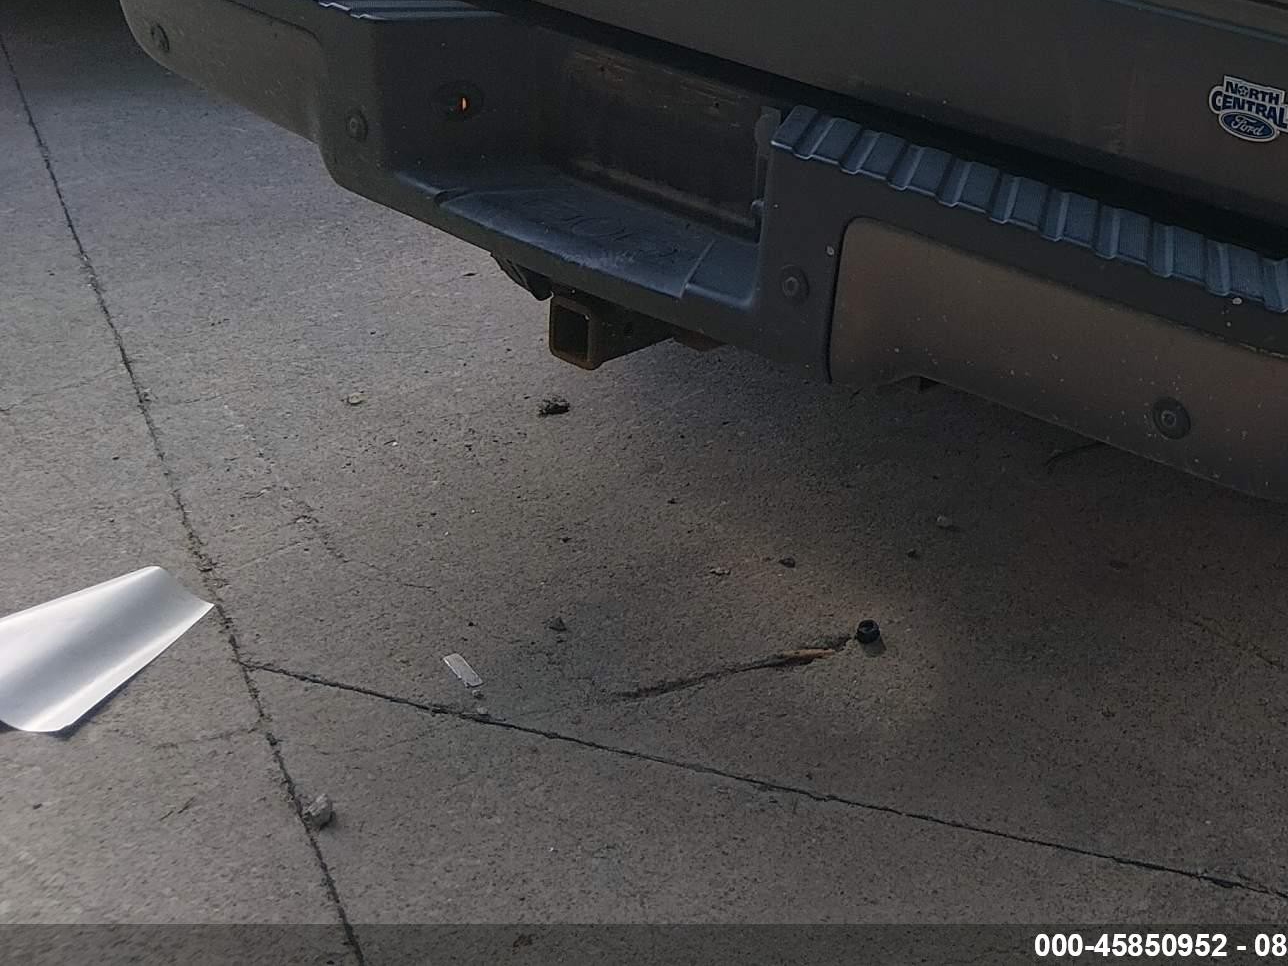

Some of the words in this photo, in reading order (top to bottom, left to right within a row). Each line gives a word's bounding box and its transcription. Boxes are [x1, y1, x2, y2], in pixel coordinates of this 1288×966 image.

[1225, 80, 1281, 106] NORTH
[1210, 89, 1288, 130] CENTRAL
[1230, 114, 1266, 136] Ford
